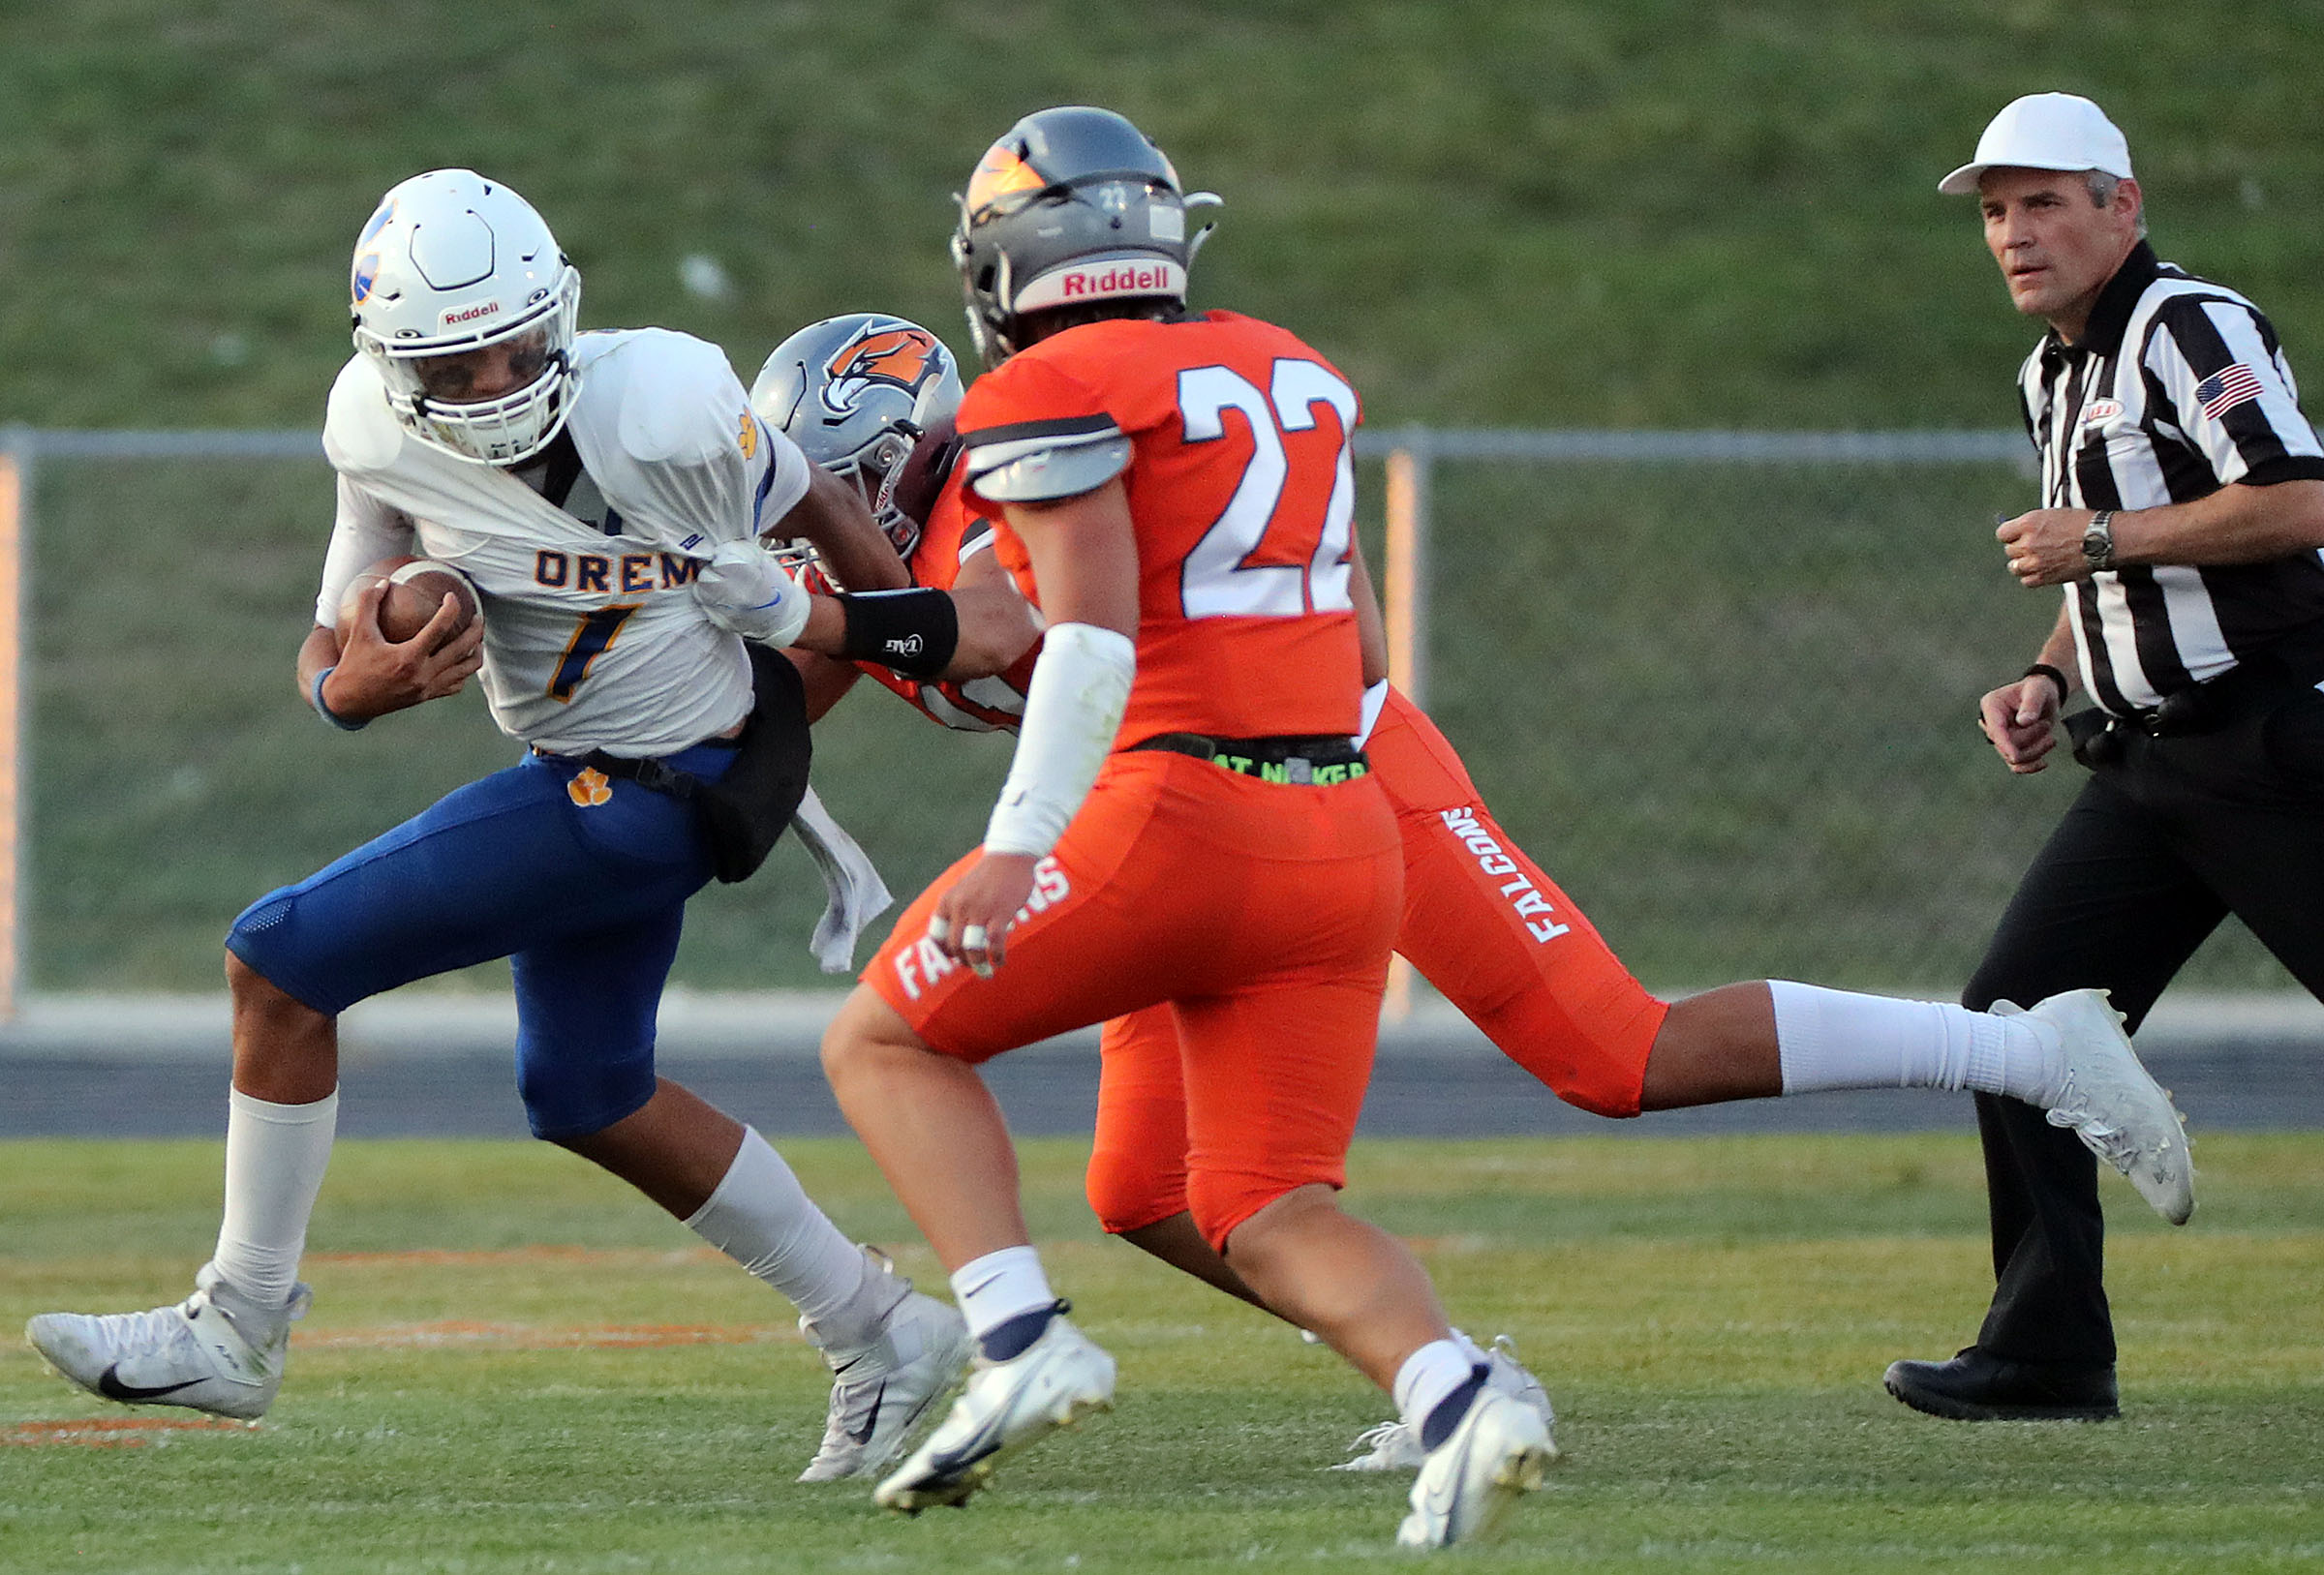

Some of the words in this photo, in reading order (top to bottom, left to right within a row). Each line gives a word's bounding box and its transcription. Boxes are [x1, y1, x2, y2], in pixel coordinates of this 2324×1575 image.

[445, 302, 499, 324] Riddell
[1064, 266, 1168, 296] Riddell
[1177, 356, 1357, 621] 22
[535, 549, 705, 595] OREM
[546, 602, 646, 705] 7
[1440, 805, 1571, 944] FALCONS
